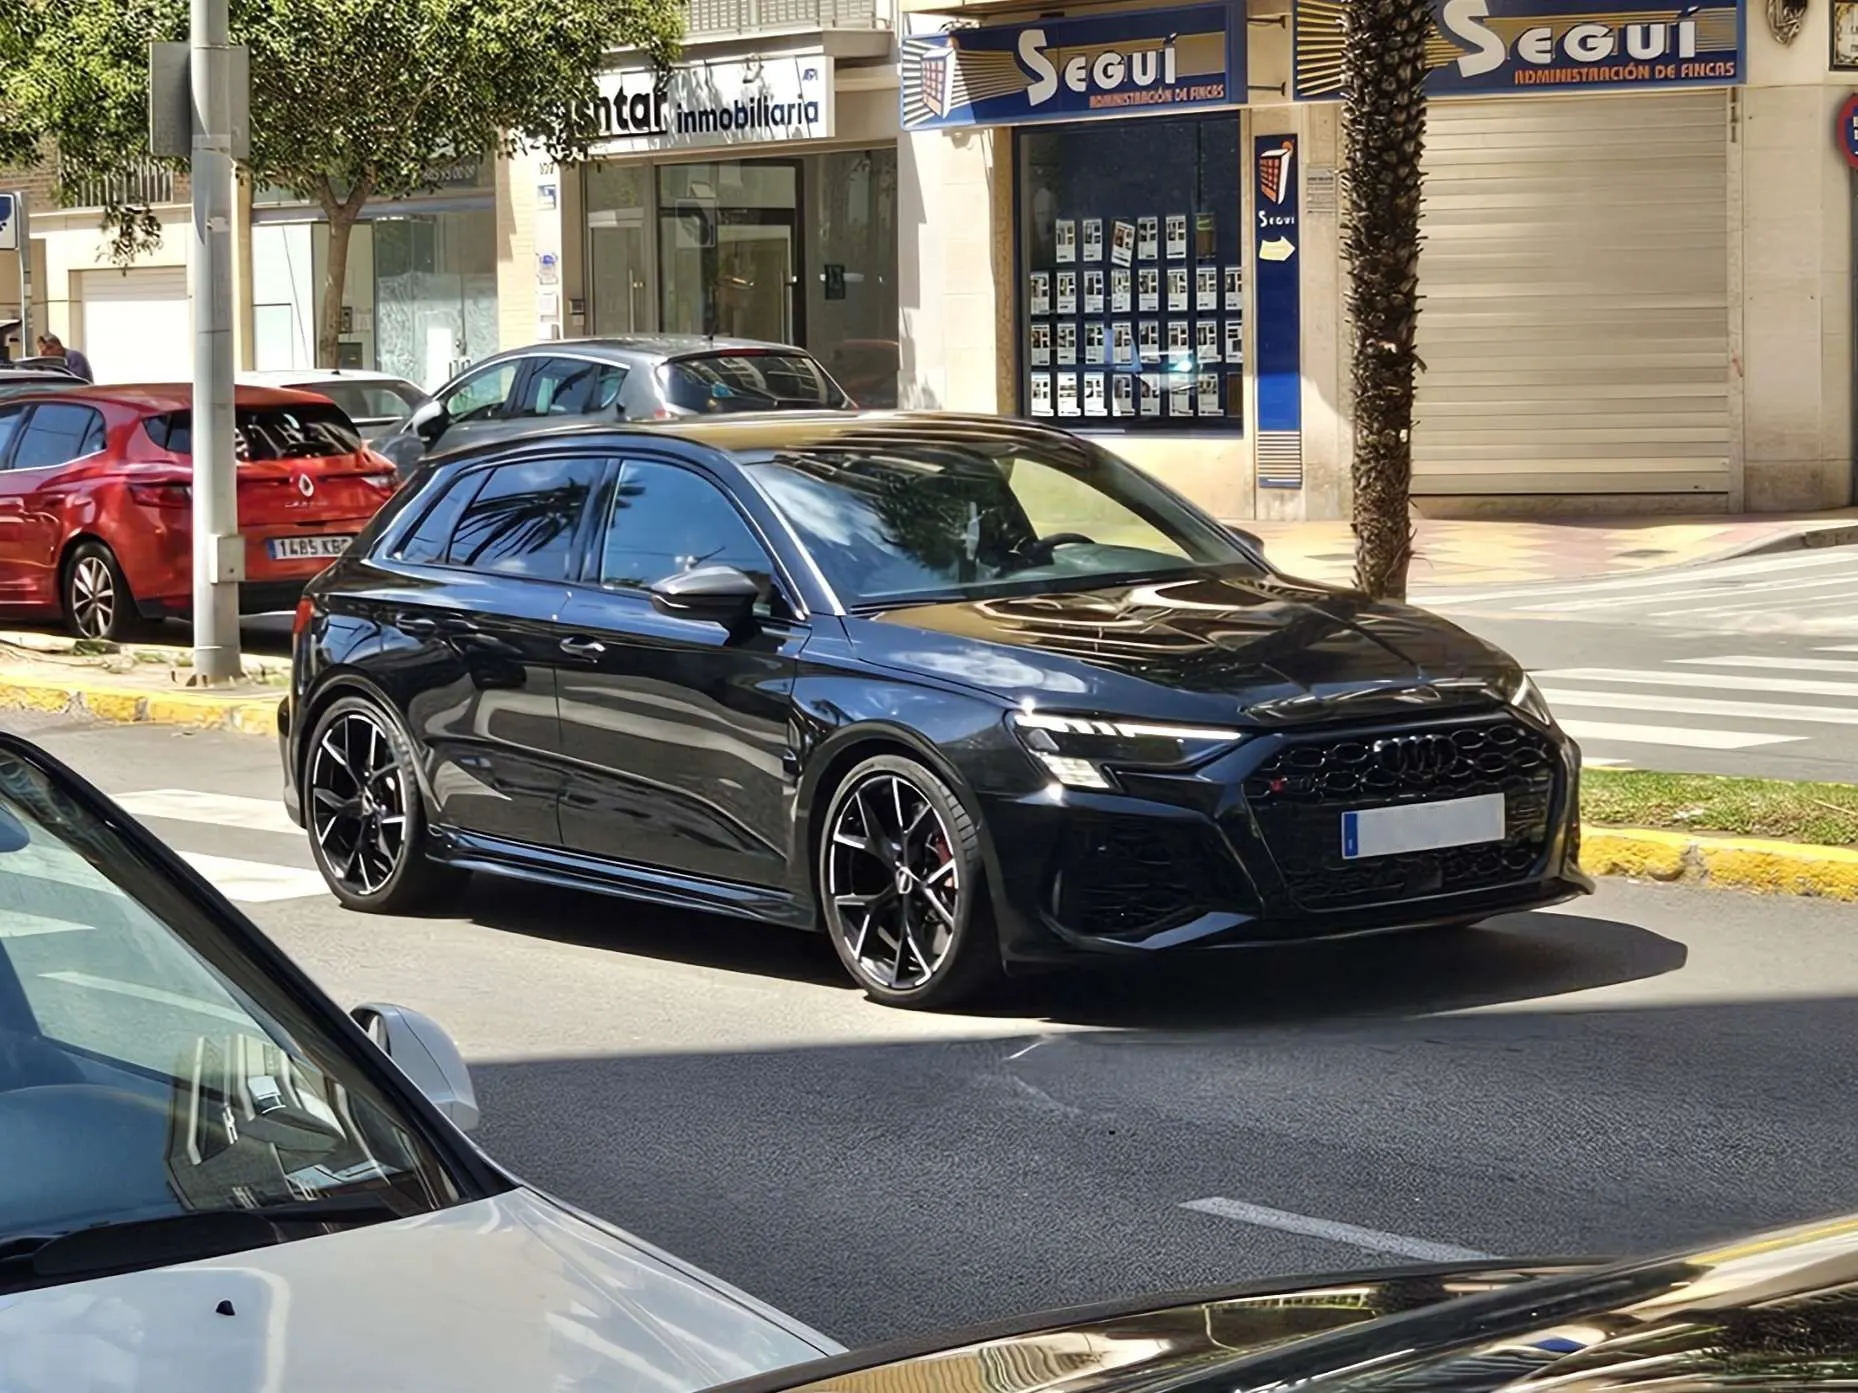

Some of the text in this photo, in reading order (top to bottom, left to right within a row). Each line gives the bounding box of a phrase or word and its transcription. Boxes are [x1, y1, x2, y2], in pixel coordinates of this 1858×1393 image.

[1515, 62, 1734, 84] ADMINISTRACIÓN DE FINCAS
[578, 86, 818, 133] ntar inmobiliaria
